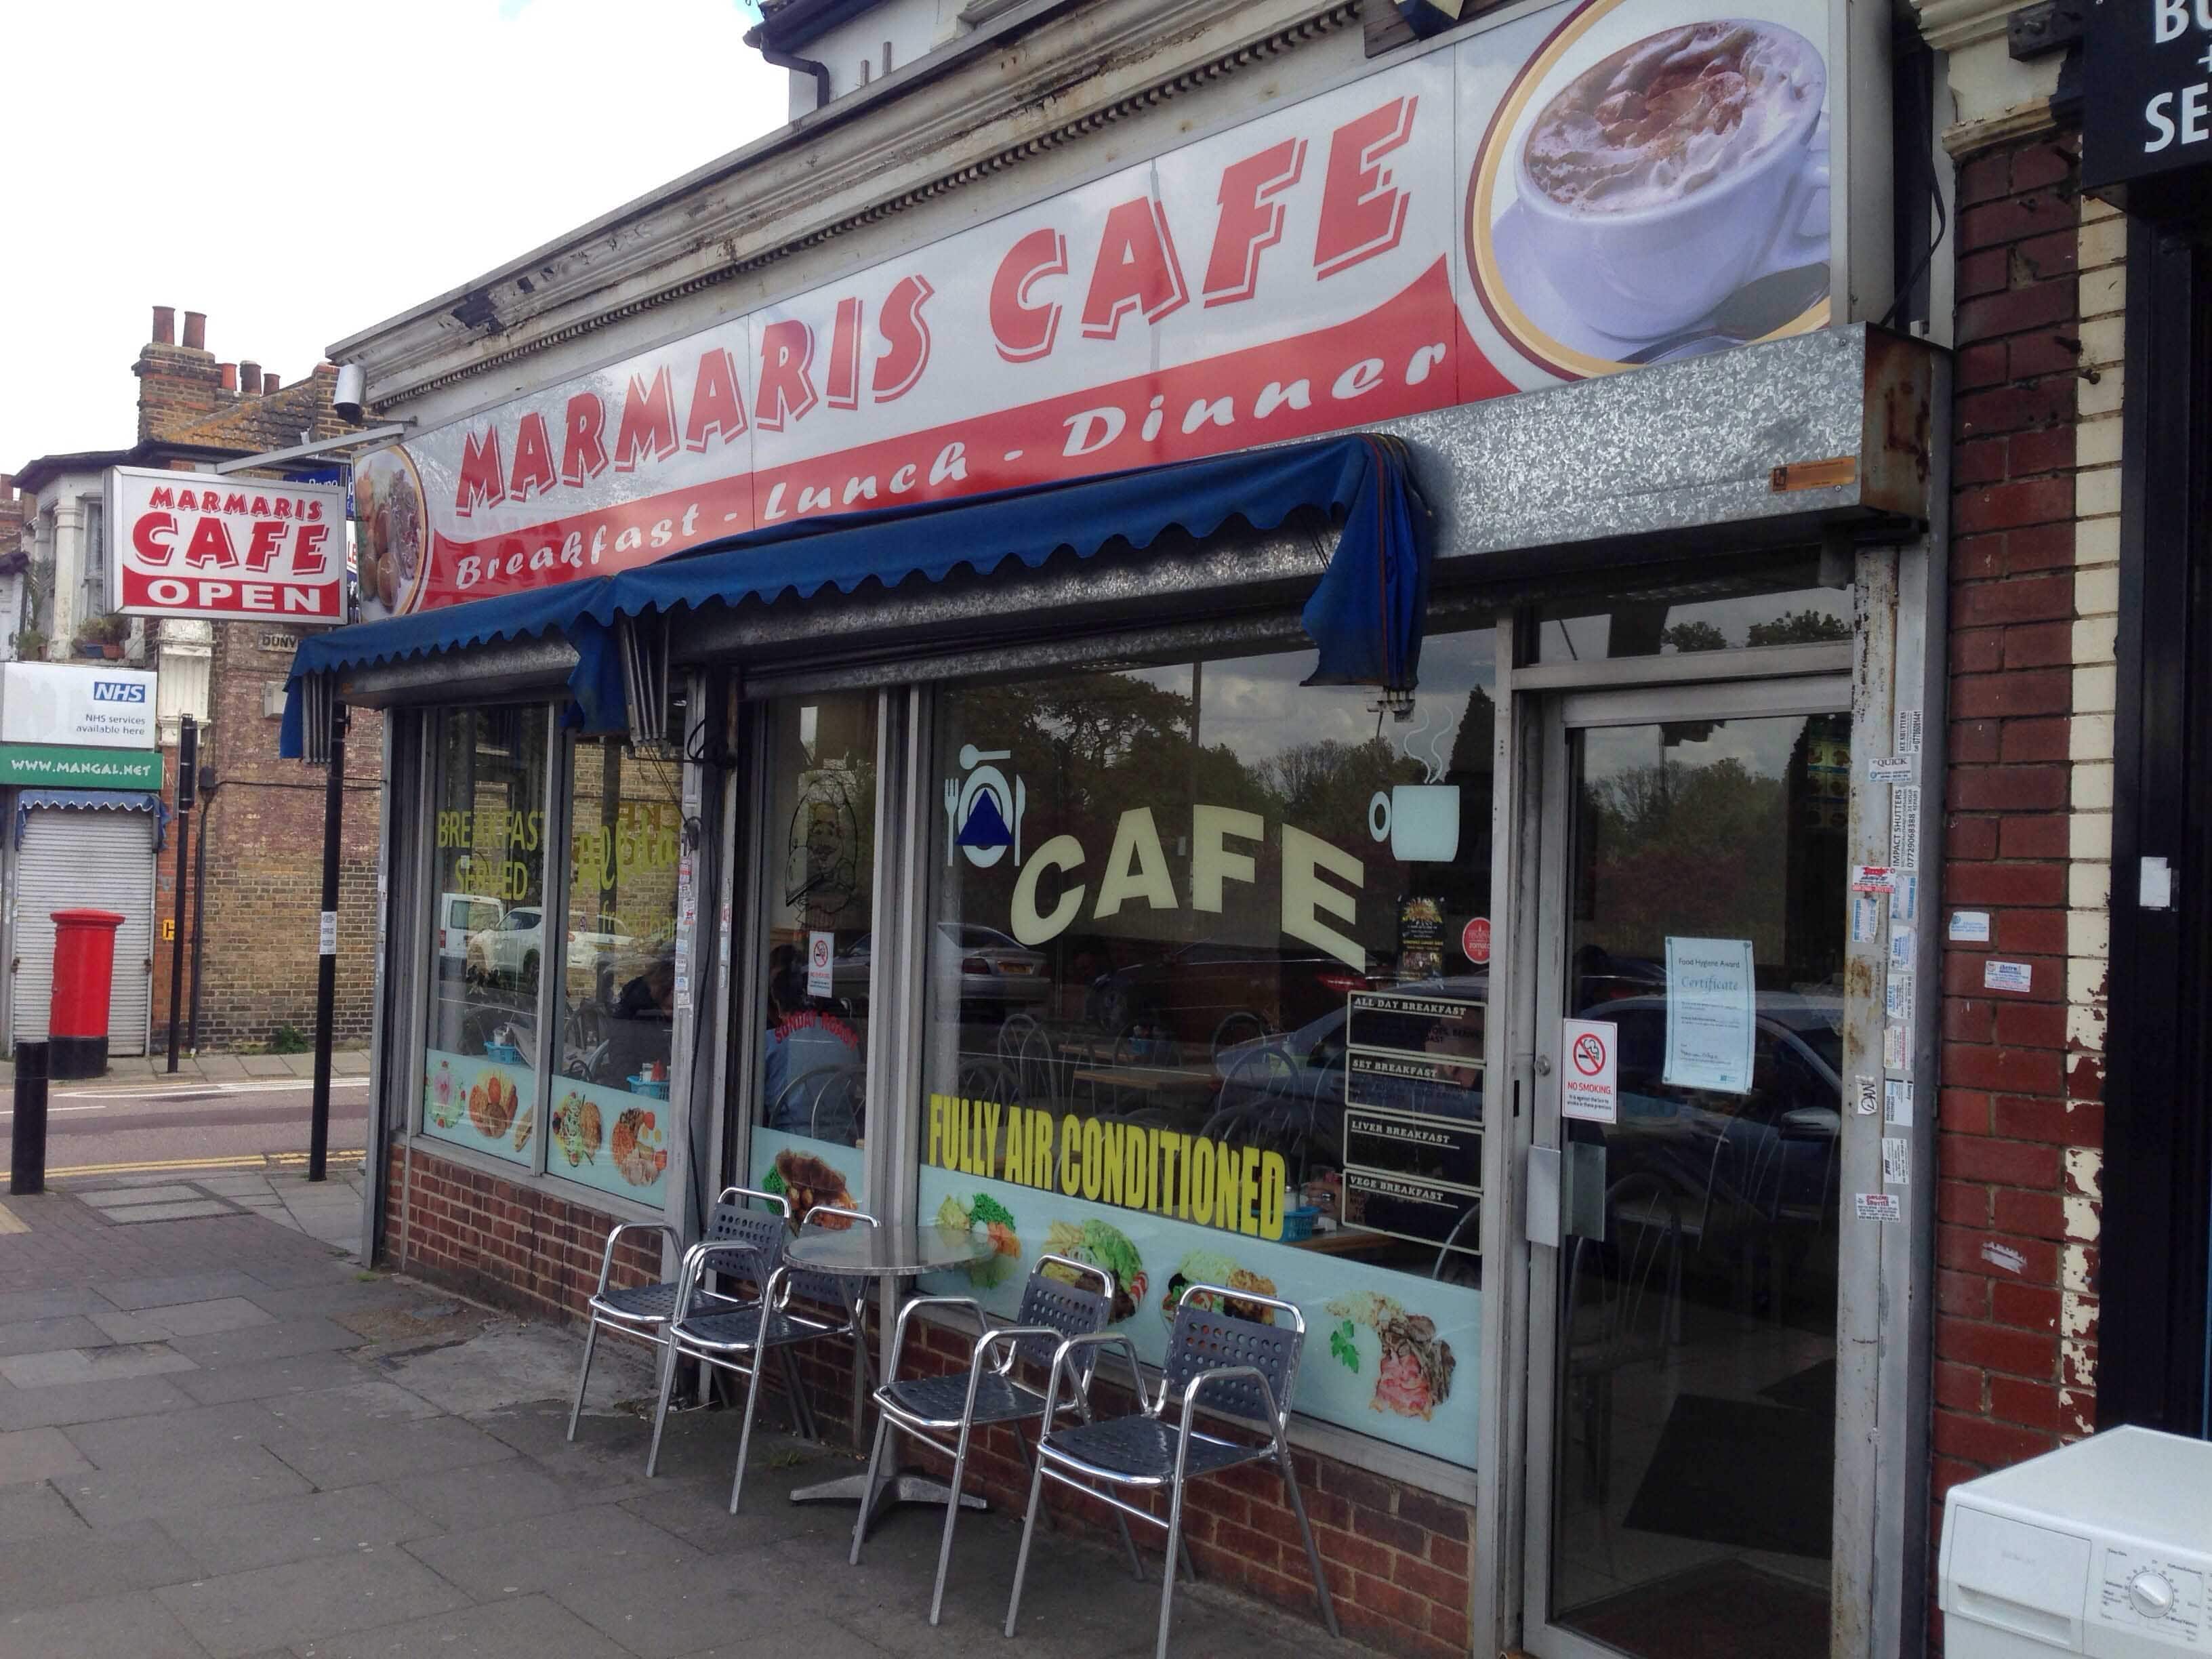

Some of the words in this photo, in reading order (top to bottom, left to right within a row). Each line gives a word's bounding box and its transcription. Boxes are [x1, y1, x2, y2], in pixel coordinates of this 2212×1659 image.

[455, 274, 935, 517] MARMARIS
[989, 95, 1418, 363] CAFE
[455, 504, 699, 590] Breakfast
[764, 441, 968, 520] Lunch
[1063, 342, 1446, 457] Dinner
[149, 486, 323, 521] MARMARIS
[132, 512, 329, 576] CAFE
[147, 579, 321, 613] OPEN
[95, 683, 144, 702] NHS
[76, 724, 119, 735] available
[123, 726, 145, 735] here
[85, 714, 106, 722] NHS
[108, 714, 146, 725] services
[11, 759, 152, 776] WWW.MANGAL.NET
[1877, 758, 1908, 767] QUICK
[1893, 789, 1902, 832] SHUTTERS
[438, 810, 545, 852] BREAKFAS
[1892, 834, 1901, 867] IMPACT
[455, 859, 529, 901] SERVED
[1010, 804, 1365, 974] CAFE
[1679, 958, 1694, 966] Food
[1695, 959, 1719, 968] Hygiene
[1719, 960, 1740, 968] Award
[1681, 976, 1738, 991] Certificate
[1355, 997, 1375, 1007] ALL
[1377, 1000, 1399, 1010] DAY
[1402, 1002, 1467, 1016] BREAKFAST
[1353, 1059, 1372, 1069] SET
[1374, 1063, 1437, 1078] BREAKFAST
[1568, 1082, 1578, 1091] NO
[1351, 1120, 1382, 1132] LIVER
[1386, 1125, 1450, 1143] BREAKFAST
[928, 1093, 1001, 1178] FULLY
[1004, 1105, 1054, 1191] AIR
[1061, 1113, 1286, 1242] CONDITIONED
[1349, 1176, 1377, 1187] VEGE
[1380, 1181, 1443, 1201] BREAKFAST
